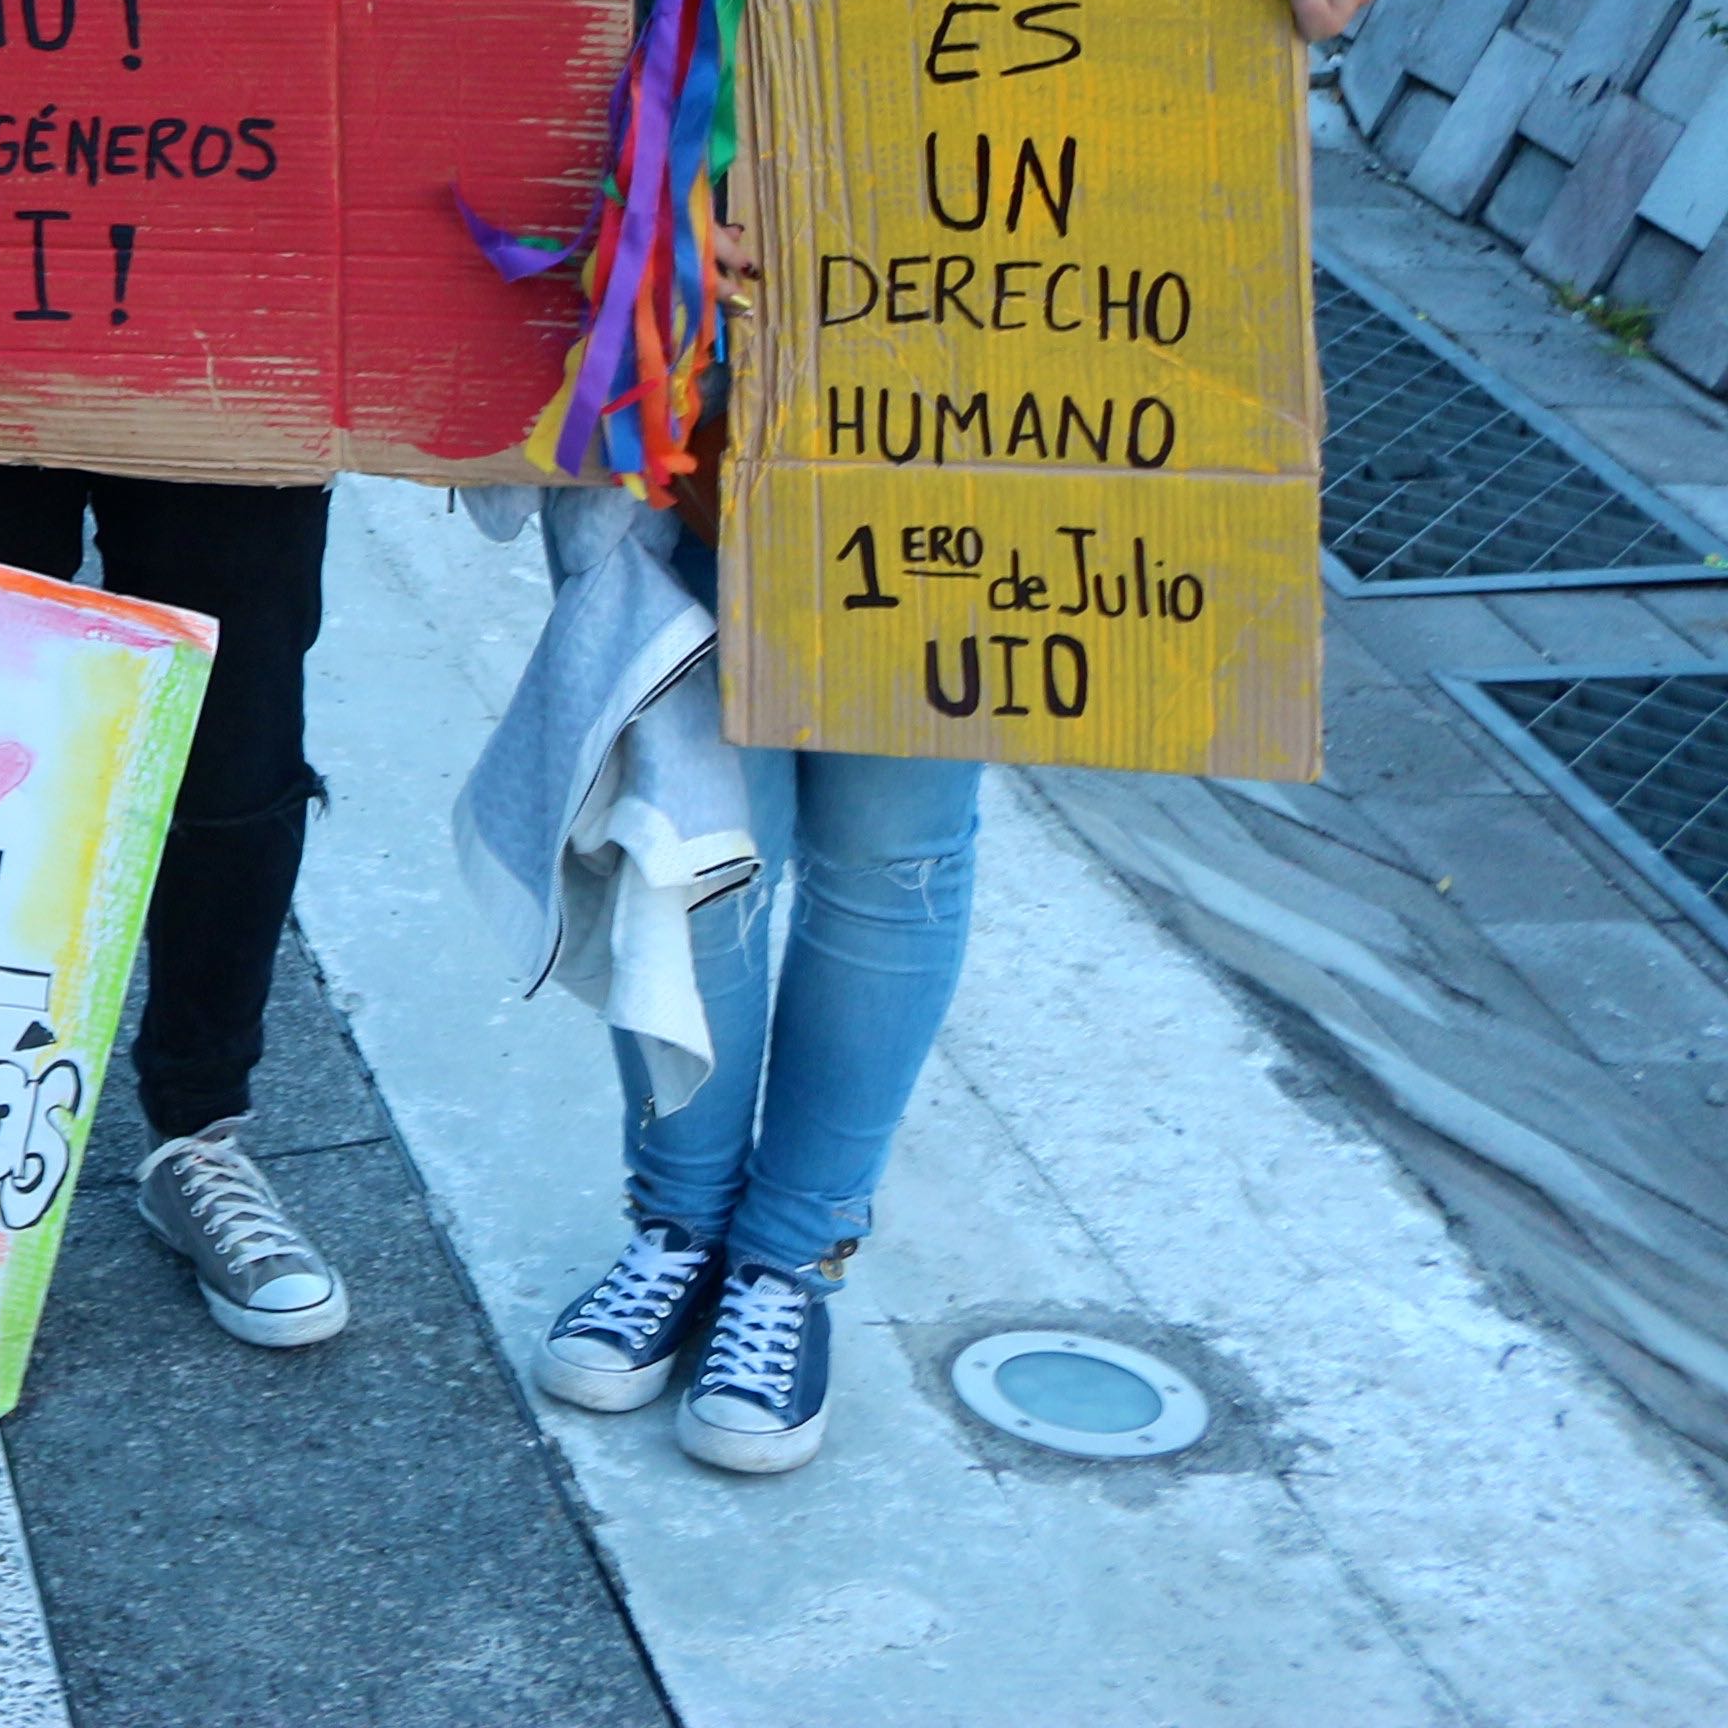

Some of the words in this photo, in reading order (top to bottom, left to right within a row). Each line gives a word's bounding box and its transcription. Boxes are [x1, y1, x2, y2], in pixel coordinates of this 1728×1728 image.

[926, 3, 1082, 83] ES
[926, 132, 1076, 236] UN
[820, 255, 1190, 345] DERECHO
[830, 387, 1176, 469] HUMANO
[988, 556, 1049, 613] de
[1057, 526, 1204, 622] Julio
